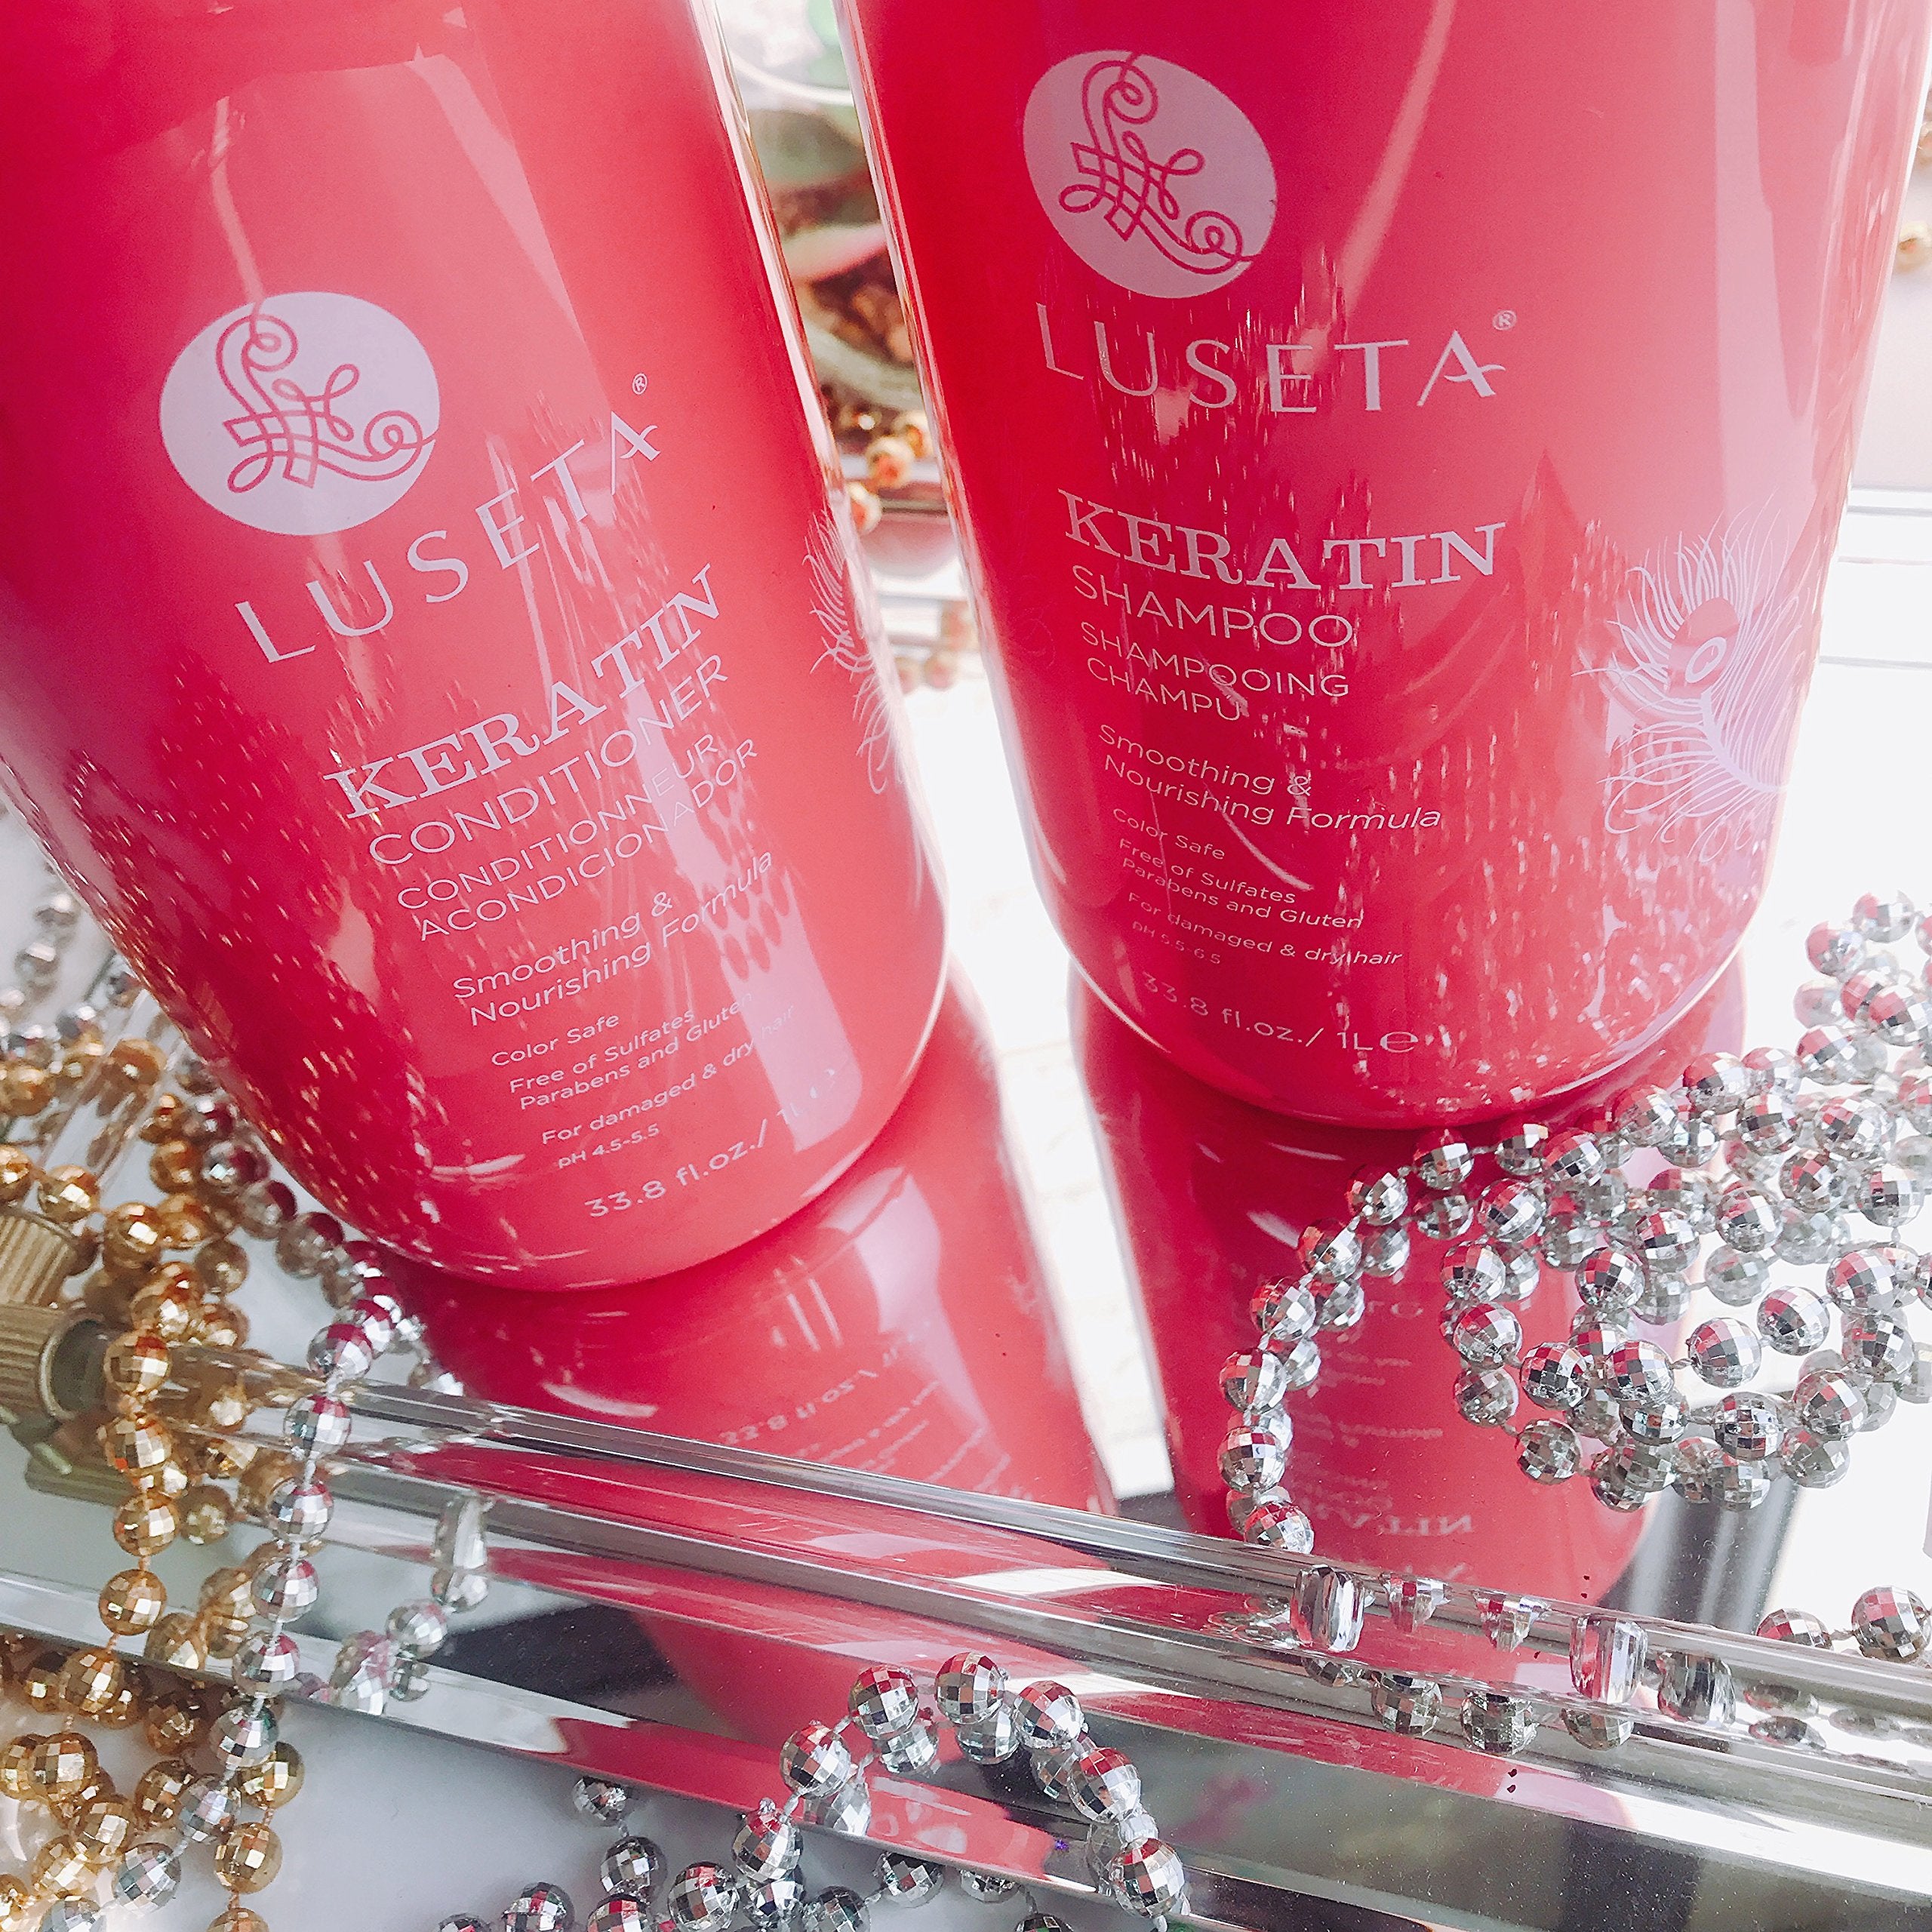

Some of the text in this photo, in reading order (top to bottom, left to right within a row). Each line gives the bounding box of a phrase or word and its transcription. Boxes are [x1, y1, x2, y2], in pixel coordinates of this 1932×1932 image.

[1036, 302, 1506, 414] LUSETA
[235, 411, 661, 664] LUSETA
[1058, 488, 1506, 590] KERATIN
[1072, 565, 1354, 648] SHAMPOO
[324, 564, 720, 819] KERATIN
[1081, 621, 1349, 697] SHAMPOOING
[370, 654, 728, 865] CONDITIONER
[1099, 724, 1312, 796] Smoothing &
[1105, 754, 1442, 830] Nourishing Formula
[398, 733, 718, 909] CONDITIONNEUR
[420, 739, 757, 940] ACONDICIONADOR
[1113, 808, 1226, 860] Color Safe
[1119, 838, 1297, 904] Free of Sulfates
[1122, 857, 1362, 930] Parabens and Gluten
[453, 891, 673, 998] Smoothing &
[472, 852, 773, 1026] Nourishing Formula
[1128, 892, 1402, 967] For damaged & dry hair
[1142, 971, 1209, 1016] 33.8
[491, 1014, 619, 1066] Color Safe
[510, 1009, 694, 1093] Free of Sulfates
[520, 992, 752, 1109] Parabens and Gluten
[541, 1122, 581, 1144] For
[589, 1072, 696, 1130] damaged
[702, 1063, 716, 1079] &
[722, 1038, 755, 1066] dry
[558, 1124, 659, 1168] pH 4.5-5.5
[586, 1181, 666, 1217] 33.8
